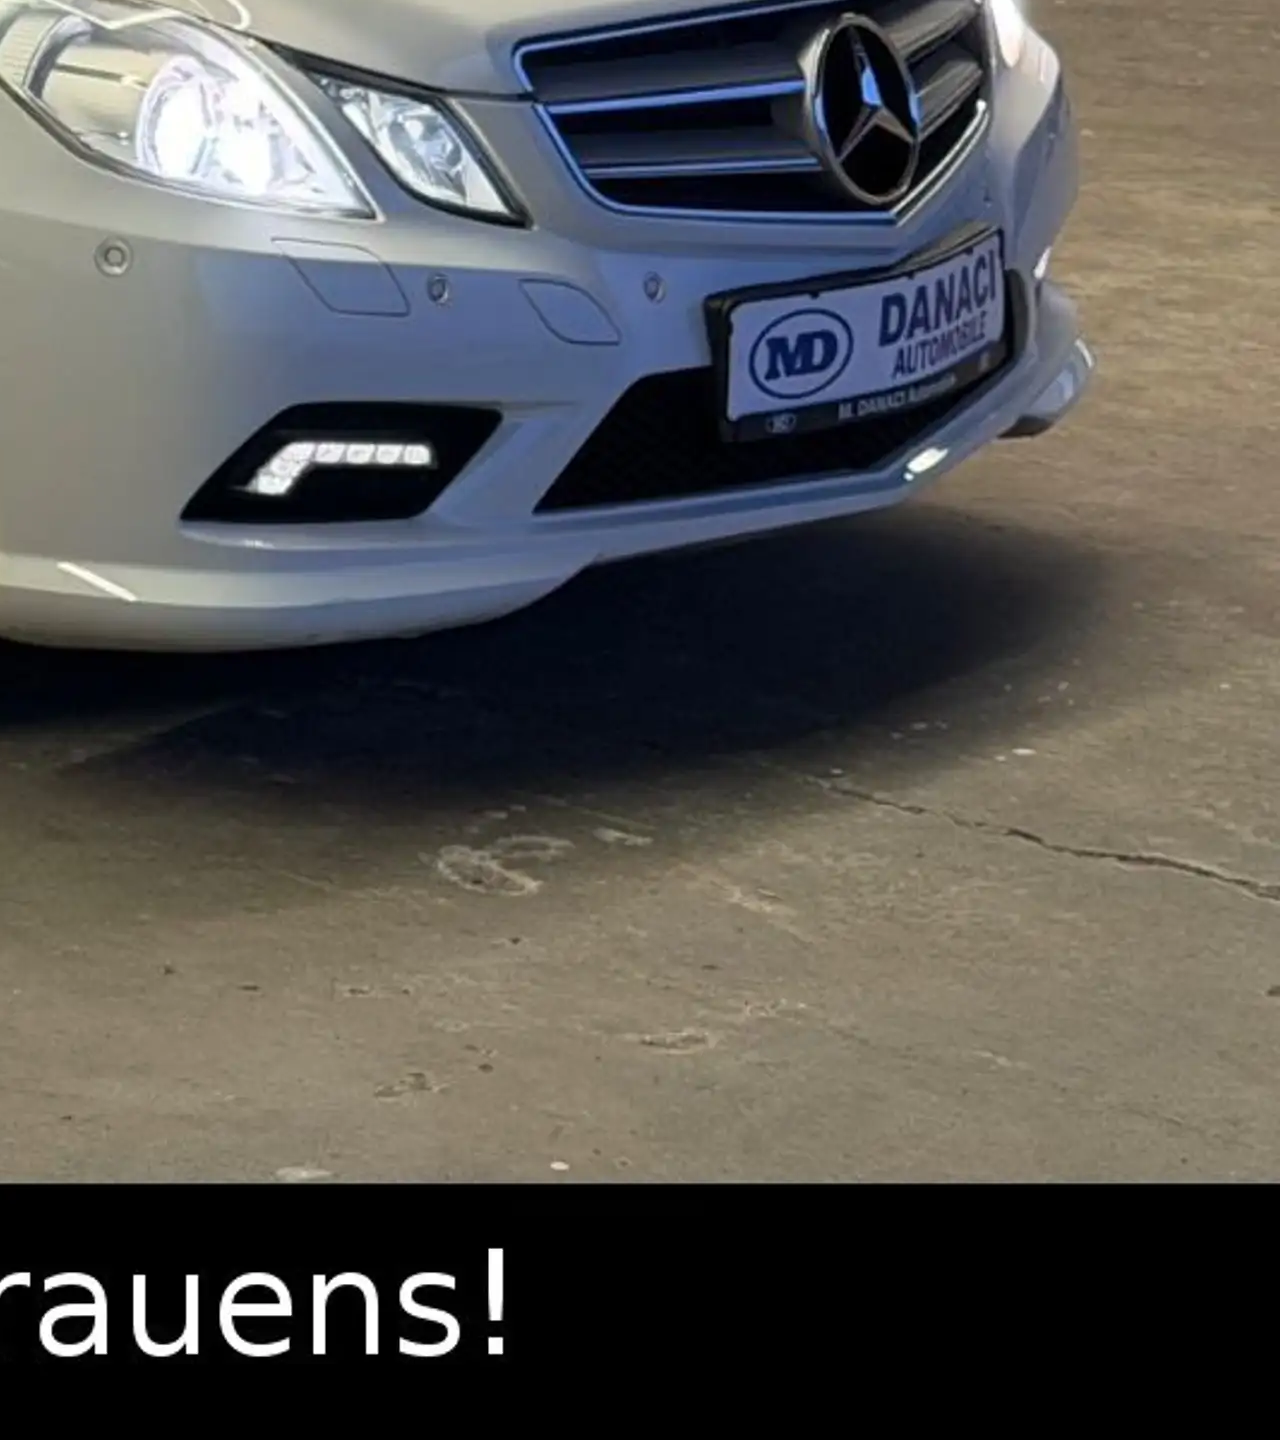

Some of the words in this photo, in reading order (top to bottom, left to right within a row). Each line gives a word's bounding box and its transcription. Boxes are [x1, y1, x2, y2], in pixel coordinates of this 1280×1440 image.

[878, 248, 996, 347] DANACI
[763, 329, 838, 381] MD
[892, 310, 988, 379] AUTOMOBILE
